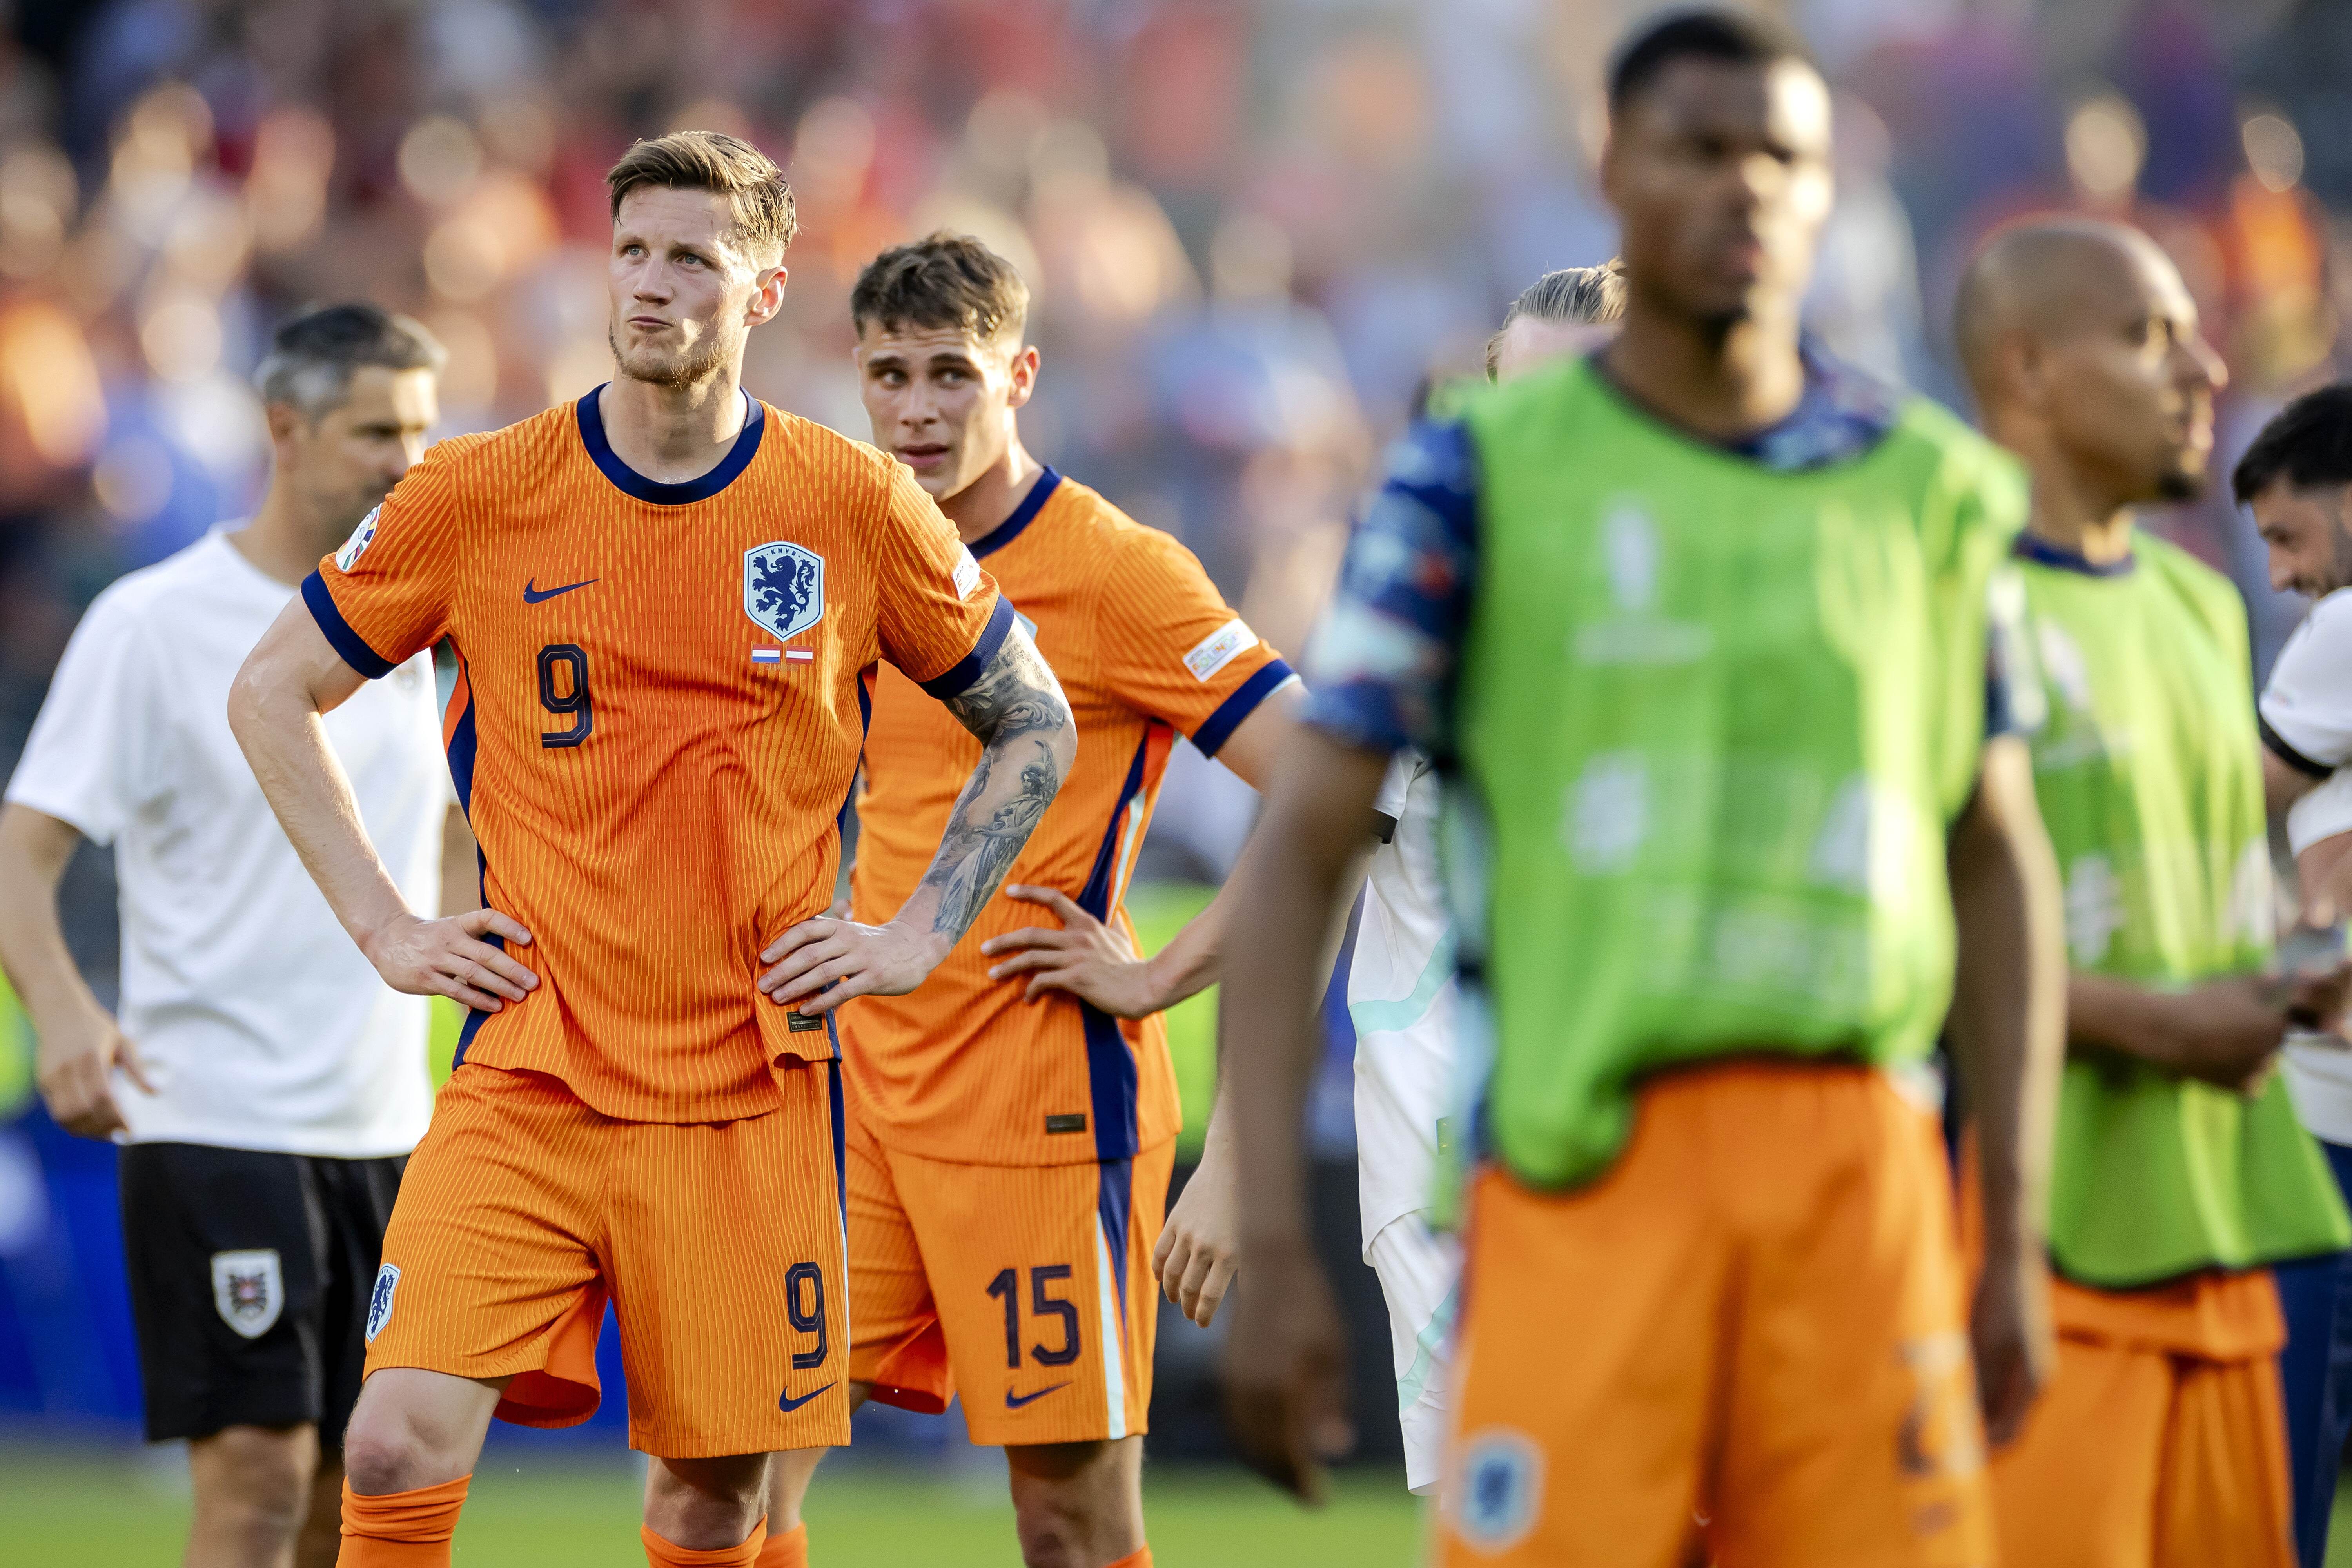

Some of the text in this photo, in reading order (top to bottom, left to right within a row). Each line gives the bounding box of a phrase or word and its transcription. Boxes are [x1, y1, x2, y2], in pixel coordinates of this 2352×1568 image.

[537, 644, 593, 748] 9
[785, 1262, 827, 1370] 9
[986, 1265, 1080, 1368] 15
